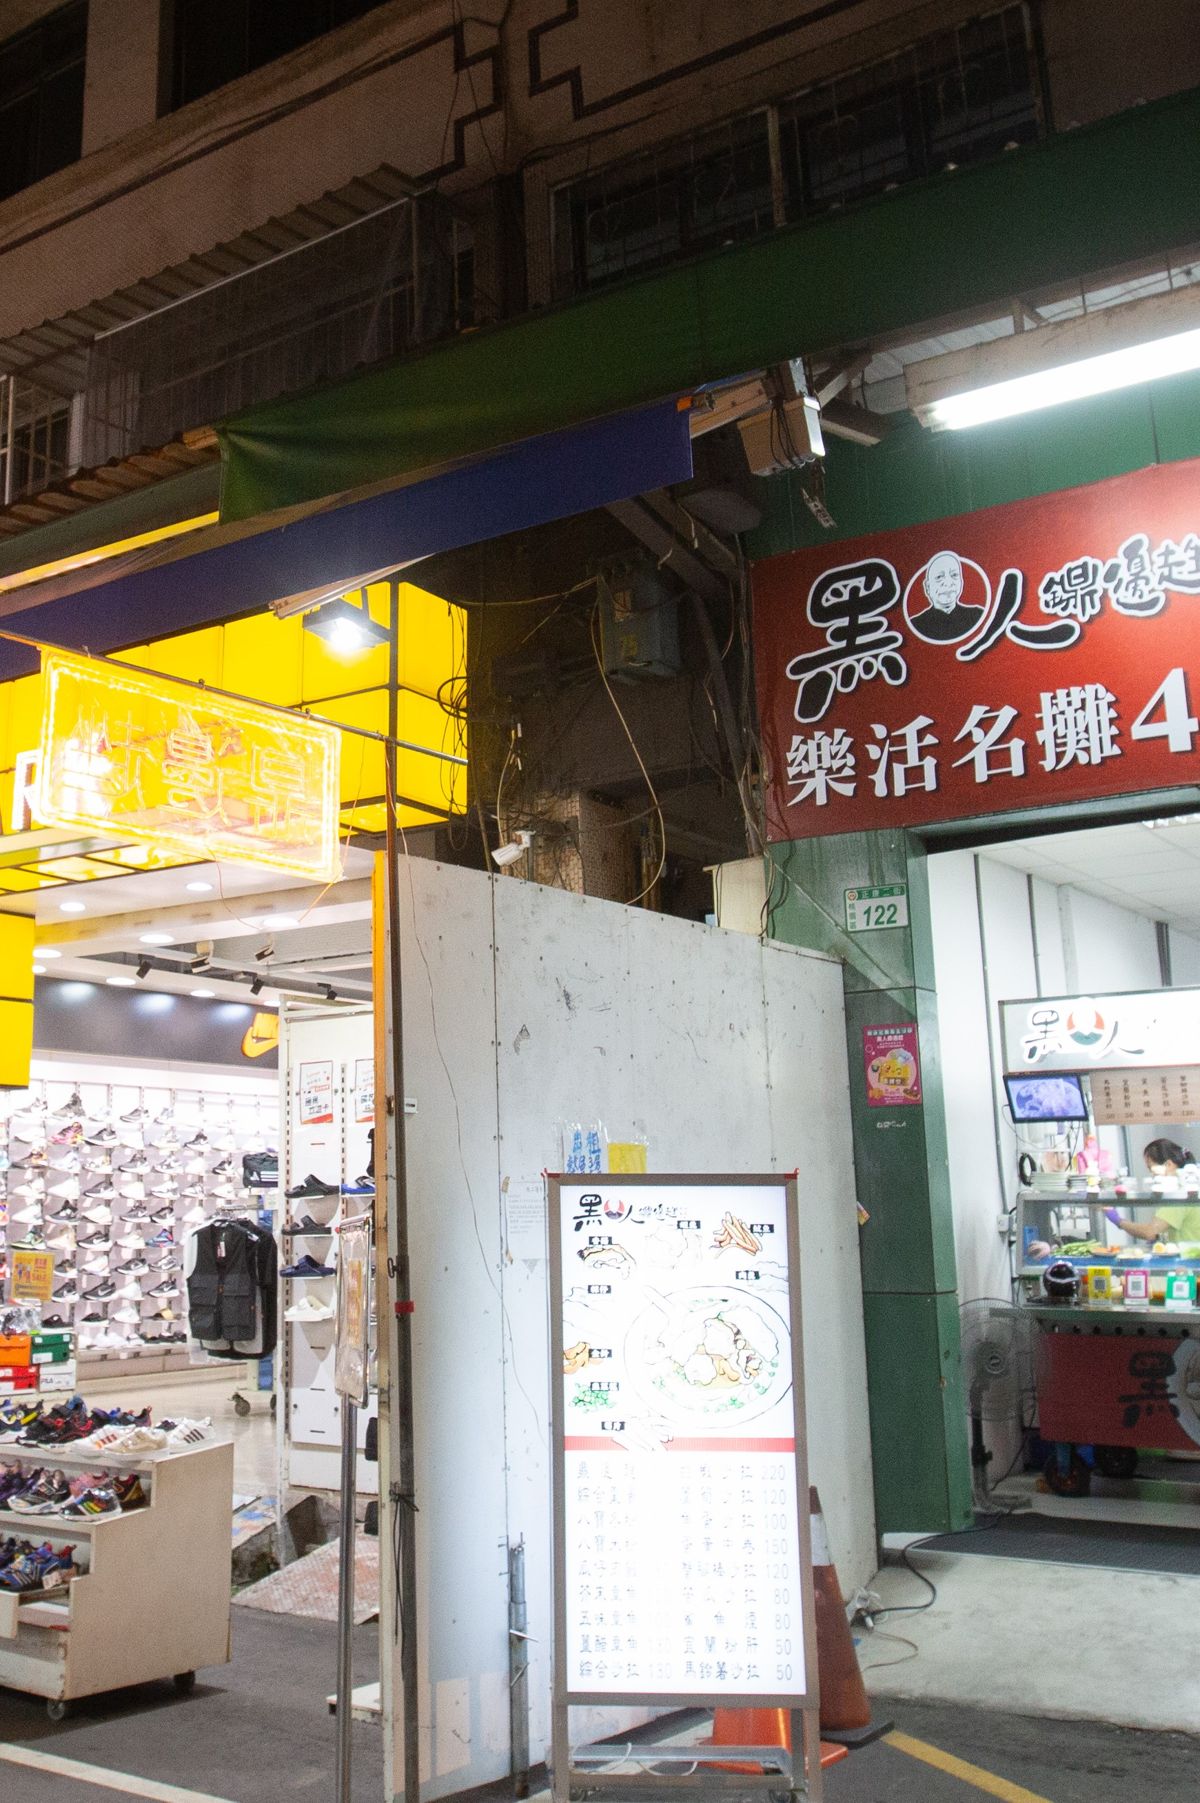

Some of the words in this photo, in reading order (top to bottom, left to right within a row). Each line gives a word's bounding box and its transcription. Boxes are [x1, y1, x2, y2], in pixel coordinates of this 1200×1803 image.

[864, 904, 898, 927] 122
[775, 1638, 792, 1655] 50
[776, 1663, 793, 1681] 50
